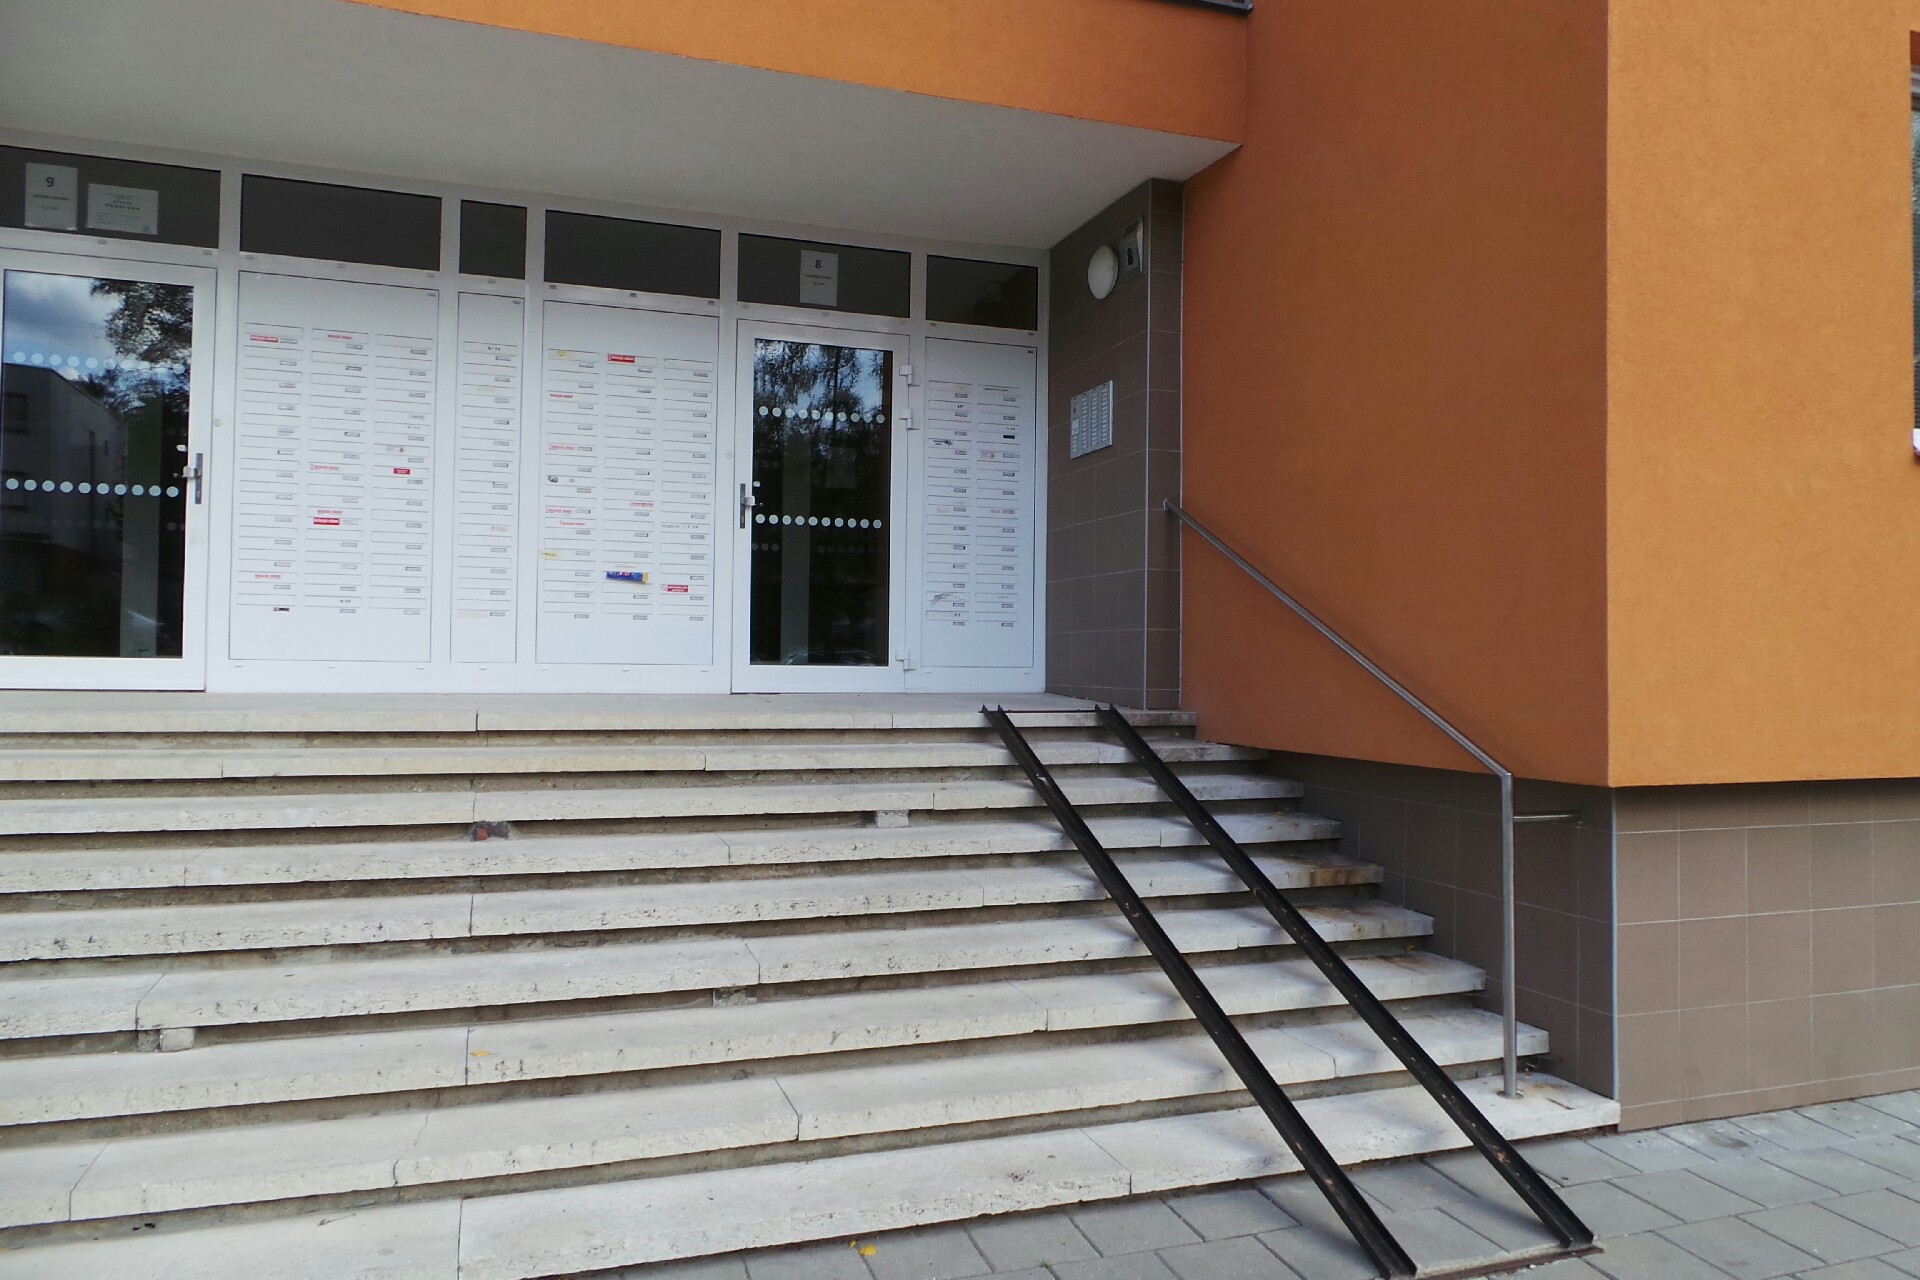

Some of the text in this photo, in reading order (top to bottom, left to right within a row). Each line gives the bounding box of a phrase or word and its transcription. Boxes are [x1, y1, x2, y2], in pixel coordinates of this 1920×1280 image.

[46, 176, 54, 187] 9
[1127, 248, 1133, 265] 8
[815, 260, 822, 269] 8
